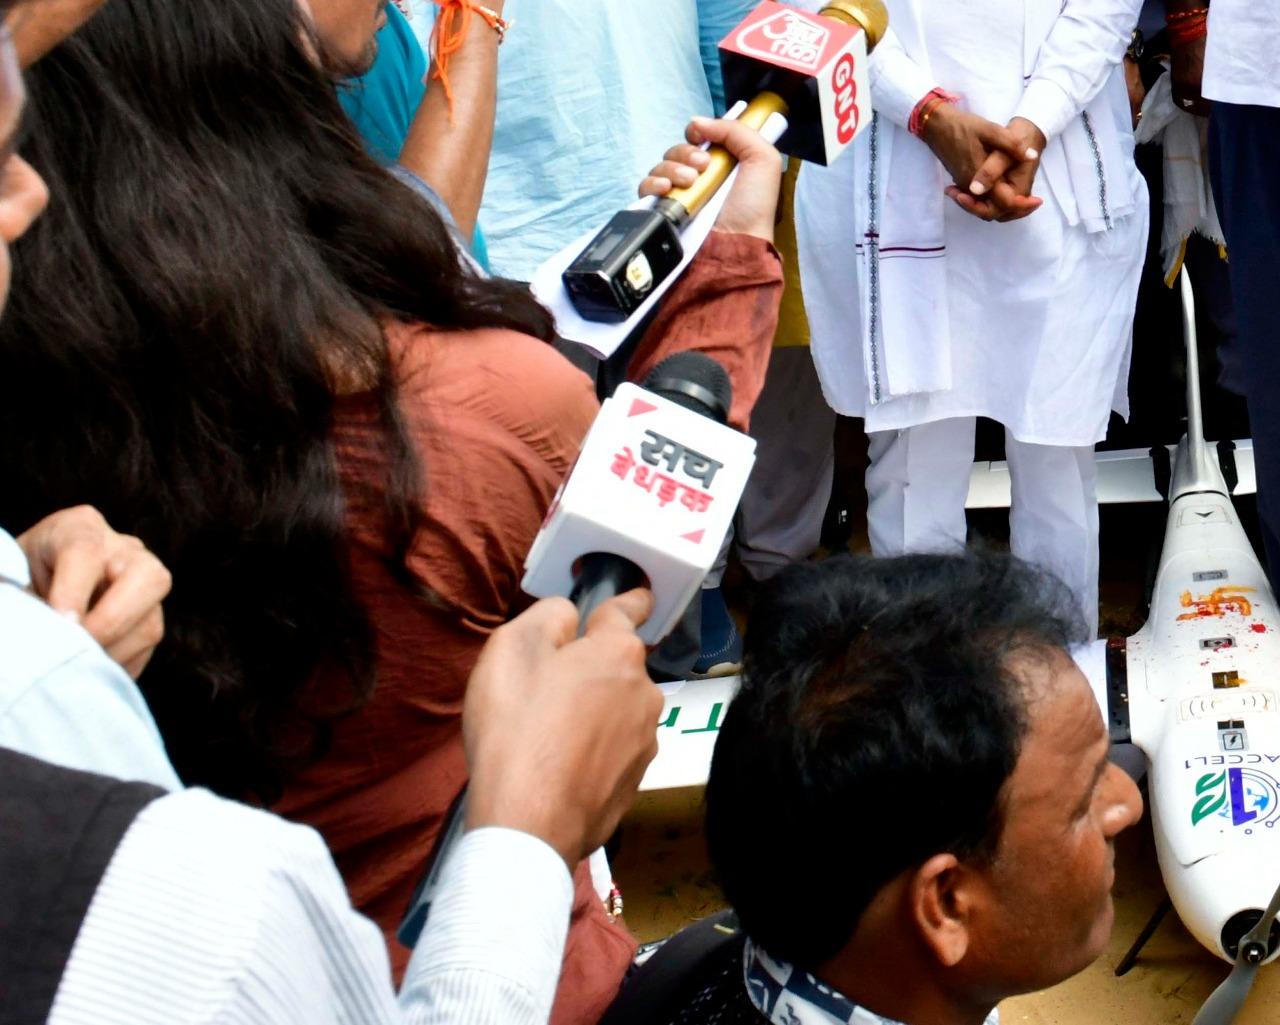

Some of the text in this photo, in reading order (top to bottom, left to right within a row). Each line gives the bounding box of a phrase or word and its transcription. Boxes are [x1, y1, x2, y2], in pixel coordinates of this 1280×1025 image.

[832, 53, 859, 144] GNT
[640, 429, 724, 489] सच
[1185, 754, 1280, 769] ACCEL1
